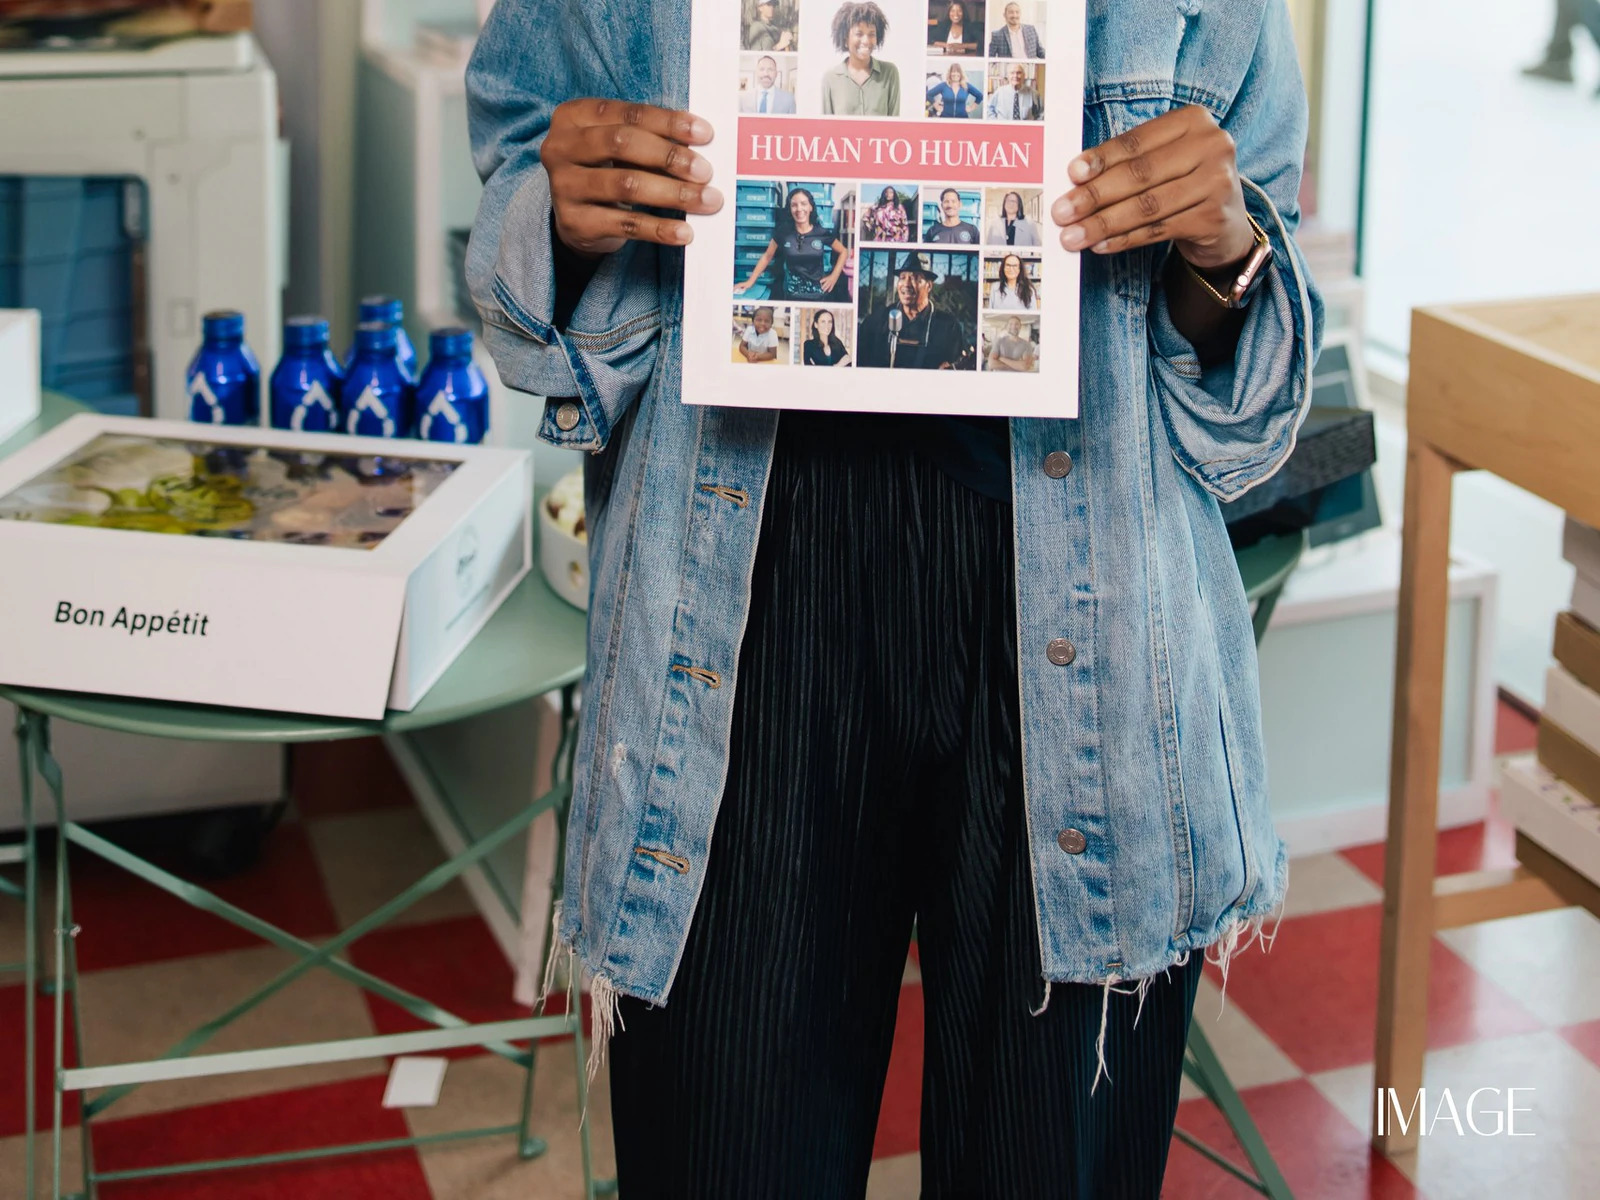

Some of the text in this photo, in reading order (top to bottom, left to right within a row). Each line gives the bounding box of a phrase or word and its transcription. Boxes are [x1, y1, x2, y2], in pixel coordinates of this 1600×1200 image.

[750, 134, 1031, 168] HUMAN TO HUMAN
[54, 600, 208, 637] Bon Appétit
